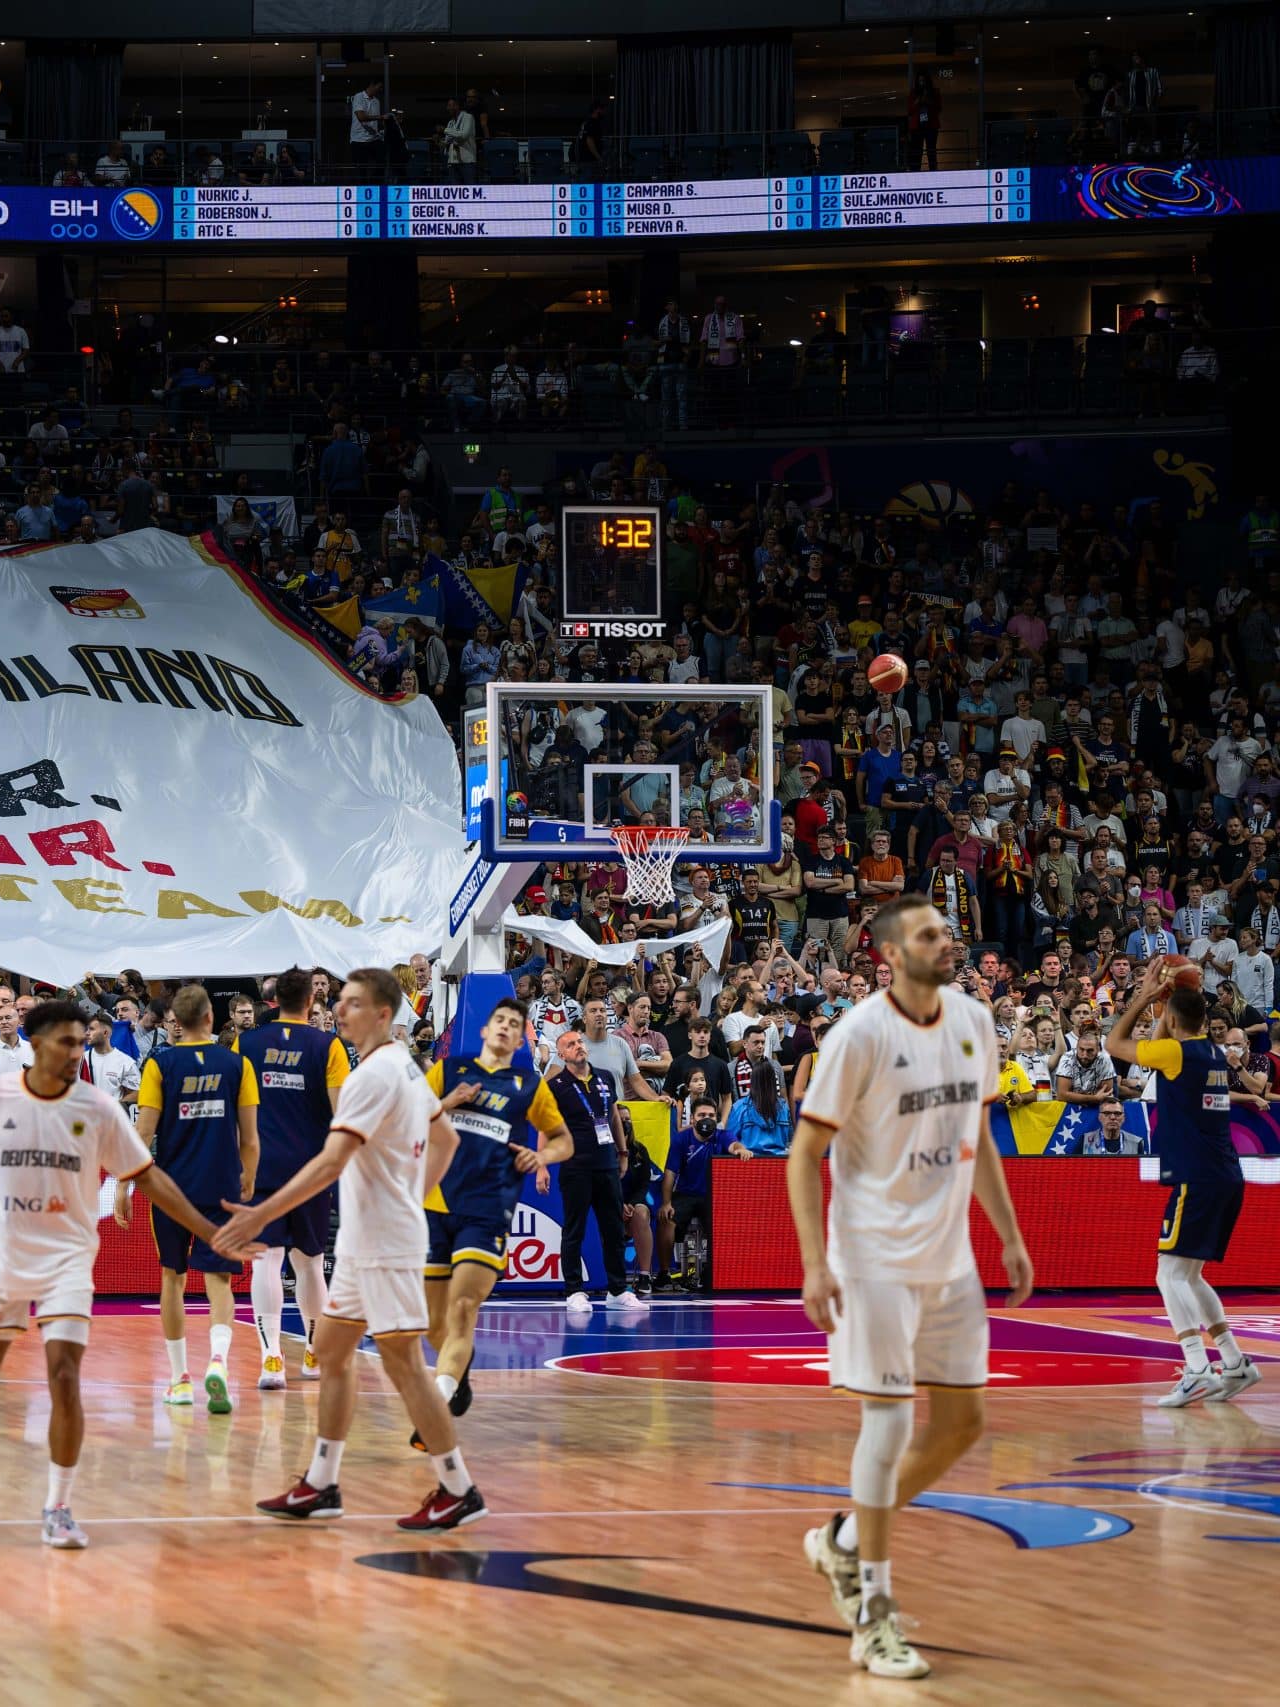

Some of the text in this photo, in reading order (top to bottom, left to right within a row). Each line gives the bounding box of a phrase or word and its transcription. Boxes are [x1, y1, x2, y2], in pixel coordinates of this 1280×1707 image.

[607, 179, 803, 198] 12 CAMPARA S. 0 0
[824, 170, 1024, 189] 17 LAZIC A. 0 0
[181, 188, 372, 202] 0 NURKIC J. 0 0
[395, 186, 587, 200] 7 HALILOVIC M. 0 0
[823, 188, 1024, 208] 22 SULEJMANOVIC E. 0 0
[50, 200, 98, 217] BIH
[181, 206, 372, 220] 2 ROBERSON J. 0 0
[395, 204, 587, 218] 9 GEGIC A. 0 0
[607, 197, 803, 216] 13 MUSA D. 0 0
[627, 220, 672, 233] PENAVA
[676, 220, 687, 232] A.
[775, 216, 782, 228] 0
[796, 215, 803, 227] 0
[823, 206, 1024, 226] 27 VRABAC A. 0 0
[181, 224, 372, 237] 5 ATIC E. 0 0
[391, 222, 587, 236] 11 KAMENJAS K. 0 0
[602, 520, 652, 548] 1:32
[590, 622, 666, 638] TISSOT
[509, 818, 526, 827] FIBA
[451, 868, 480, 926] EUROBASKET
[477, 1090, 510, 1112] IH
[451, 1113, 505, 1136] telemach
[0, 1150, 81, 1172] DEUTSCHLAND
[910, 1147, 952, 1171] ING
[5, 1197, 42, 1212] ING
